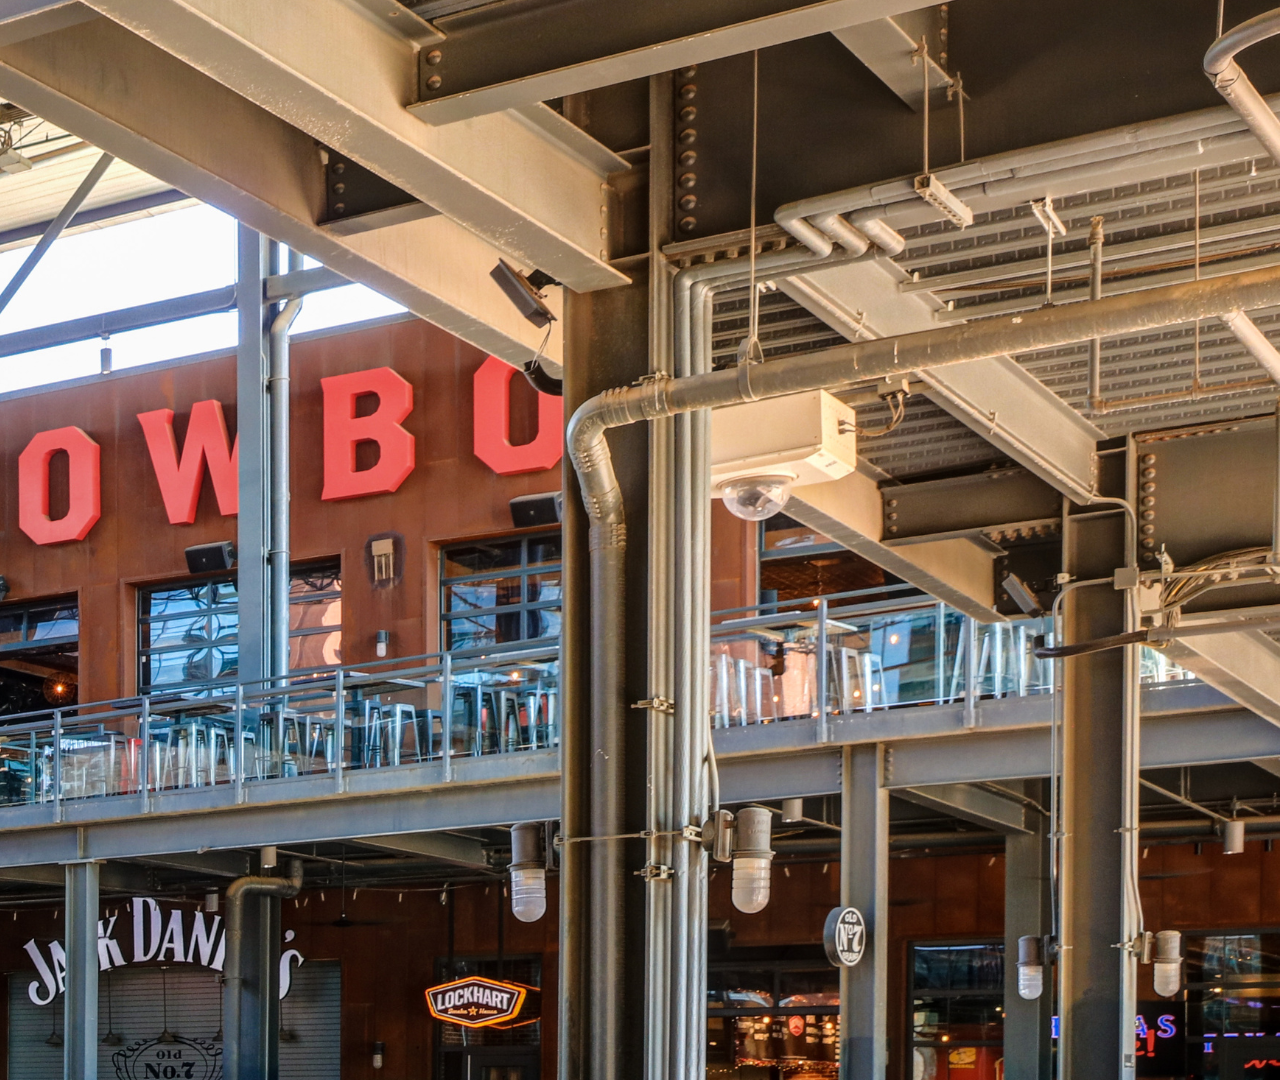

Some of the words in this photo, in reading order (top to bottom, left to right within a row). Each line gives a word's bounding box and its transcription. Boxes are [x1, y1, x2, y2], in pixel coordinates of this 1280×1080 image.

[436, 986, 511, 1011] LOCKHART
[155, 1049, 183, 1061] Old
[143, 1061, 196, 1080] No.7
